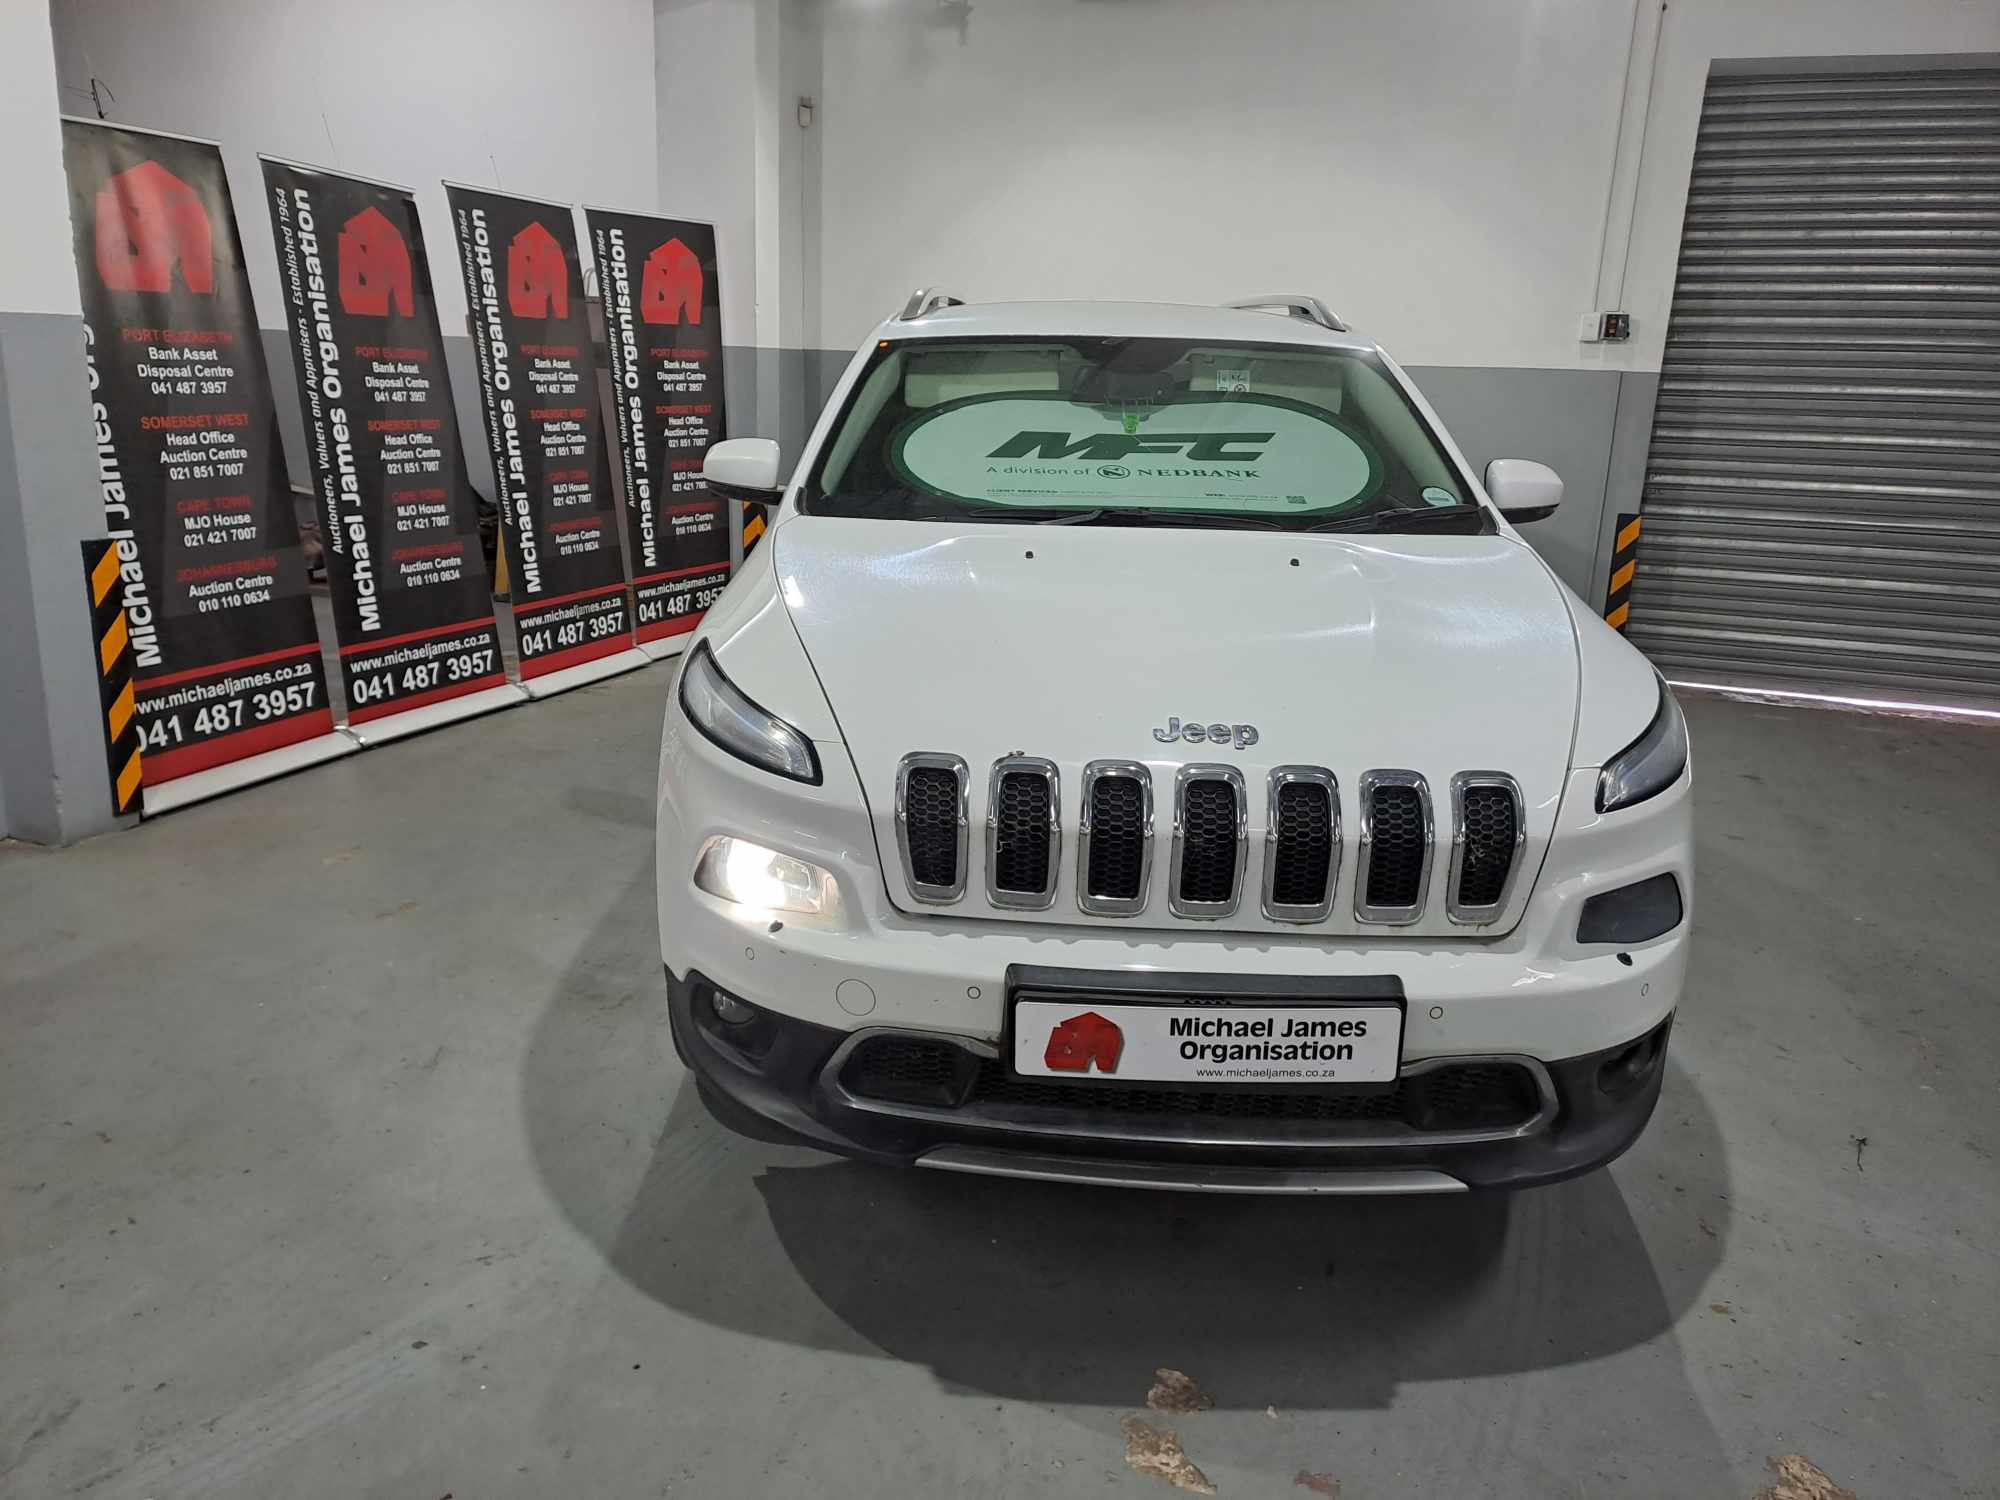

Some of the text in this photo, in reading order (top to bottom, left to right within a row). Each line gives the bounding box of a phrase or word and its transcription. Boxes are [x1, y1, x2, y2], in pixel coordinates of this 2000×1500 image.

[463, 244, 480, 310] Established
[148, 347, 218, 360] Bank Asset
[474, 319, 491, 383] Appraisers
[137, 364, 234, 379] Disposal Centre
[275, 187, 344, 554] Auctioneers, Valuers and Appraisers Established 1964
[372, 362, 419, 374] Bank Asset
[151, 381, 228, 394] 041 487 3957
[365, 376, 429, 389] Disposal Centre
[374, 392, 388, 402] 041
[472, 208, 542, 593] Michael James Organisation
[484, 384, 496, 407] and
[610, 228, 656, 567] Michael James Organisation
[615, 382, 624, 404] and
[293, 189, 381, 632] Michael James Organisation
[141, 414, 249, 429] SOMERSET WEST
[543, 421, 580, 431] Head Office
[668, 416, 703, 425] Head Office
[167, 431, 235, 446] Head Office
[385, 434, 432, 445] Head Office
[489, 409, 503, 452] Valuers
[540, 434, 586, 445] Auction Centre
[664, 428, 688, 437] Auction
[160, 447, 248, 463] Auction Centre
[380, 448, 441, 460] Auction Centre
[985, 431, 1276, 461] MFC
[170, 463, 244, 480] 021 851 7007
[387, 463, 402, 474] 021
[422, 461, 439, 471] 7007
[1003, 466, 1068, 475] division
[1073, 467, 1089, 476] of
[1137, 469, 1261, 478] NEDBANK
[497, 457, 513, 526] Auctioneers,
[569, 483, 589, 492] House
[418, 503, 446, 514] House
[184, 513, 251, 530] MJO House
[397, 516, 450, 531] 021 421 7007
[94, 402, 161, 668] Michael James
[184, 527, 257, 547] 021 421 7007
[555, 532, 580, 544] Auction
[400, 557, 462, 574] Auction Centre
[189, 574, 273, 598] Auction Centre
[407, 569, 461, 588] 010 110 0634
[637, 573, 725, 599] www.michaeljames.co.za
[199, 591, 271, 613] 010 110 0634
[638, 602, 663, 622] 041
[667, 594, 691, 615] 487
[520, 597, 621, 629] www.michaeljames.co.za
[522, 611, 623, 656] 041 487 3957
[350, 632, 490, 674] www.michaeljames.co.za
[353, 649, 494, 704] 041 487 3957
[194, 700, 243, 735] 487
[252, 681, 316, 720] 3957
[1152, 717, 1259, 750] Jeep
[1169, 1017, 1367, 1038] Michael James
[1179, 1041, 1353, 1064] Organisation
[1196, 1067, 1335, 1081] www.michaeljames.co.za
